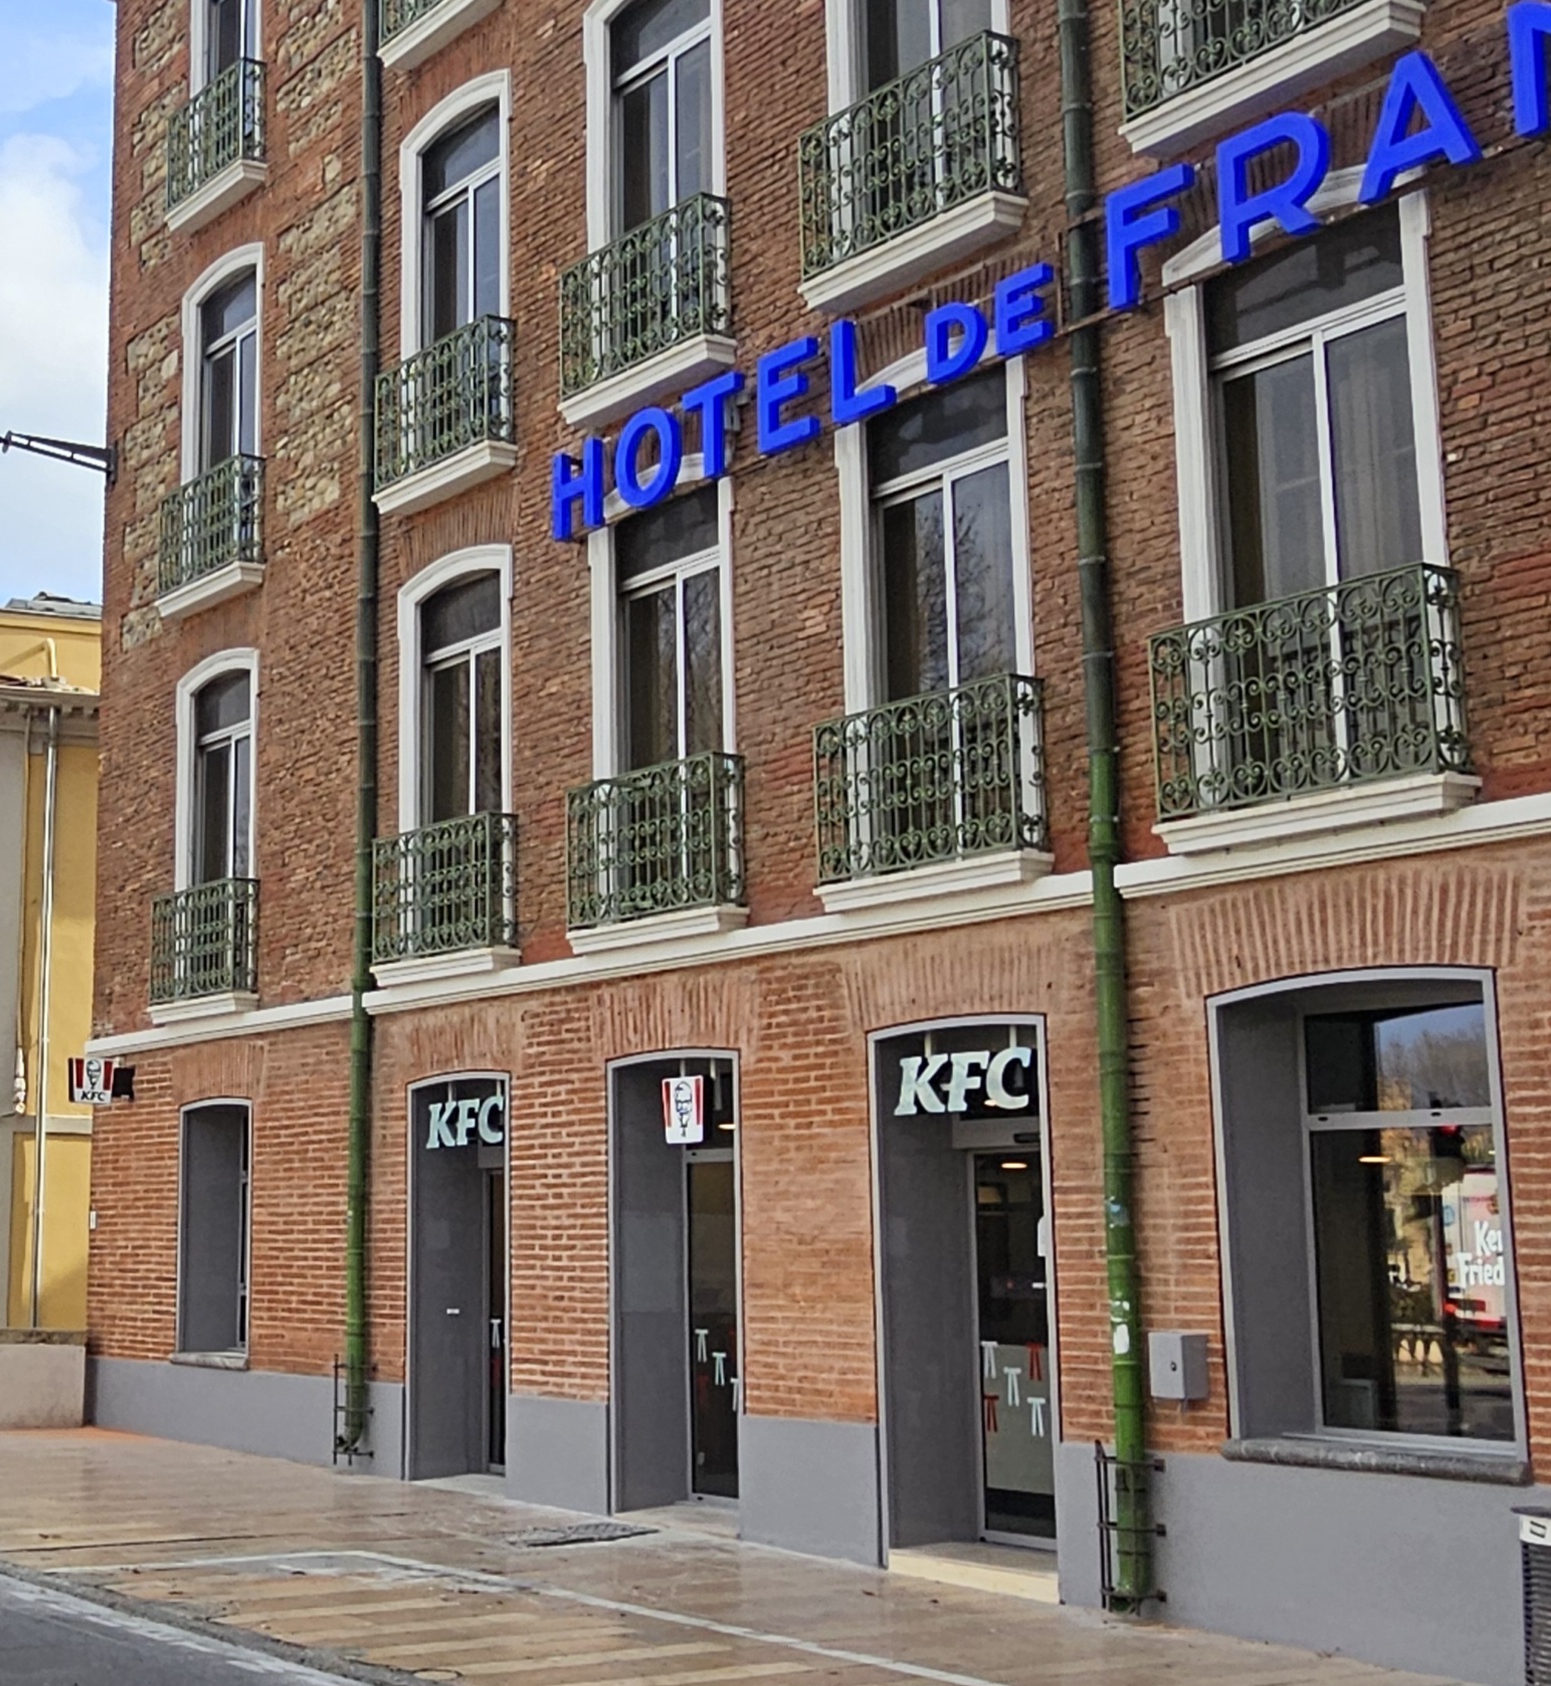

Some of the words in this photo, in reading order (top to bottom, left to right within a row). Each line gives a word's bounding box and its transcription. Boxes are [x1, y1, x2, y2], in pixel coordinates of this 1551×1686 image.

[552, 319, 897, 542] HOTEL
[925, 262, 1054, 385] DE
[80, 1090, 106, 1102] KFC
[893, 1046, 1032, 1116] KFC
[425, 1095, 504, 1149] KFC
[1456, 1252, 1505, 1289] Fried
